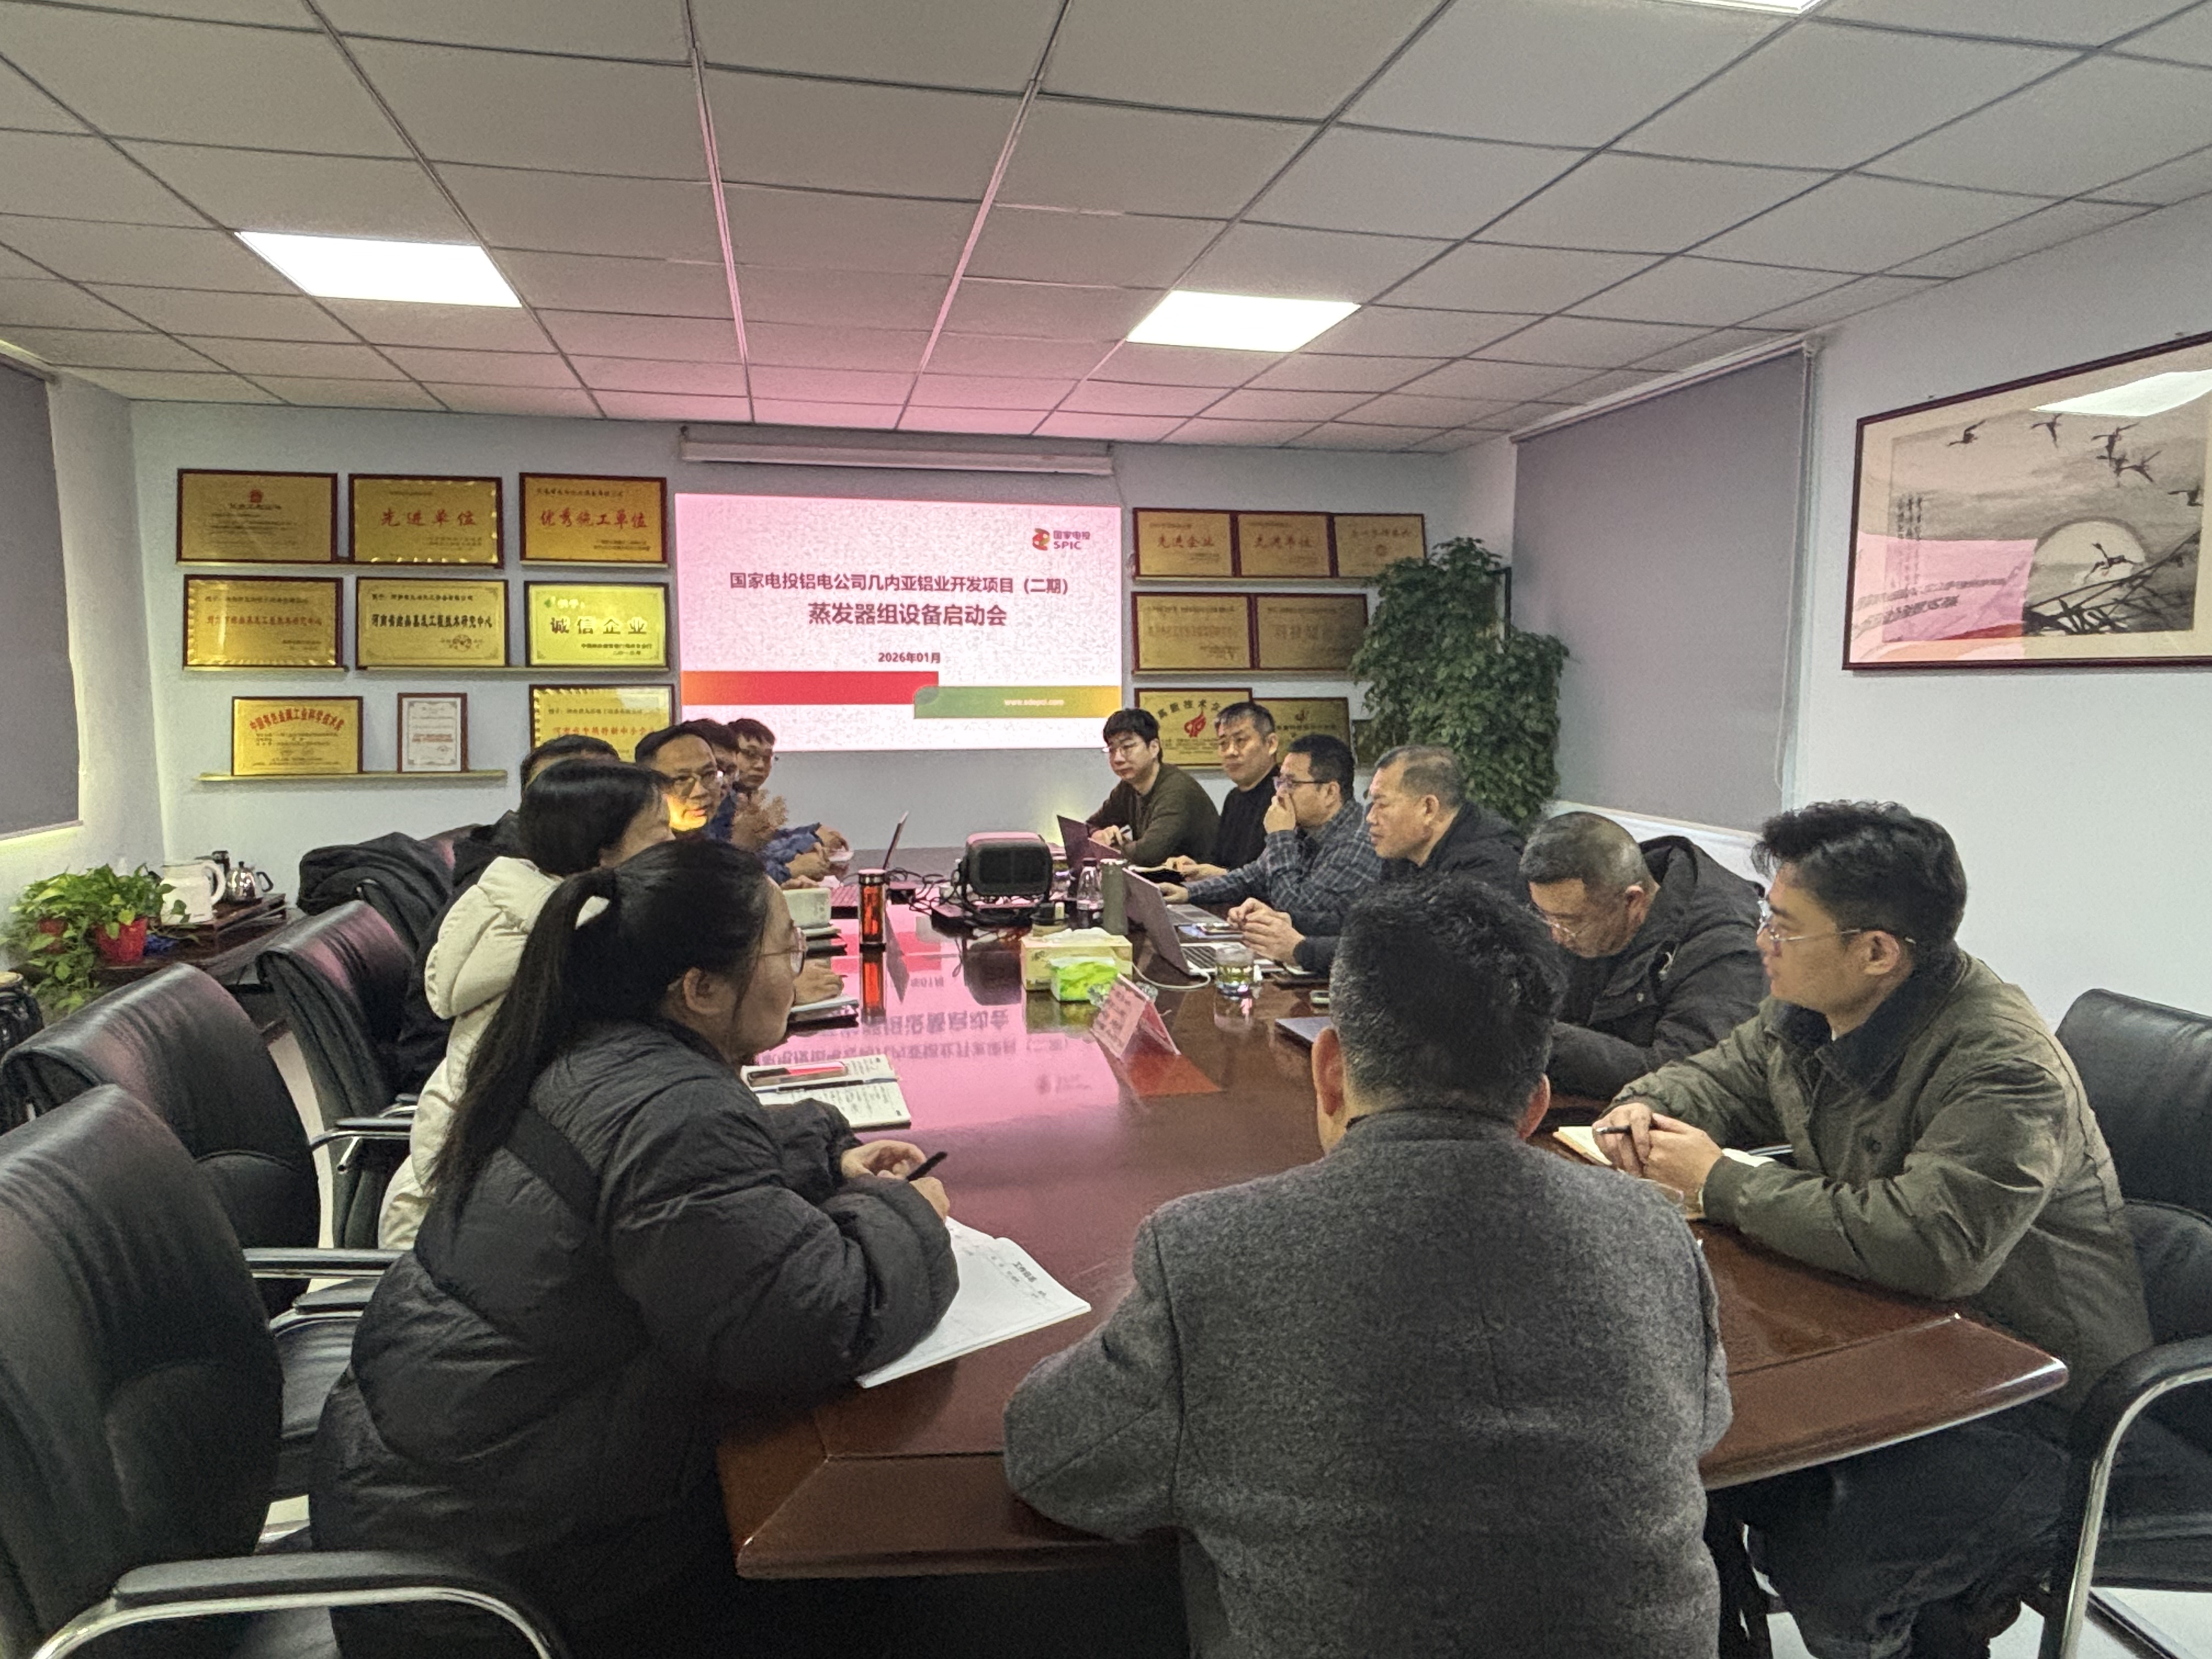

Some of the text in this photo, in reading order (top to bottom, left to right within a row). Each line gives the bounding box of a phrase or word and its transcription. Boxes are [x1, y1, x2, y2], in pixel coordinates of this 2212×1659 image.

[381, 507, 476, 527] 先进单位
[540, 507, 648, 529] 优秀施工单位
[1053, 531, 1091, 540] 国家电投
[1053, 541, 1081, 550] SPIC
[730, 572, 1068, 594] 国家电投铝电公司几内亚铝业开发项目（二期）
[808, 601, 1007, 626] 蒸发器组设备启动会
[550, 616, 647, 635] 诚信企业
[878, 652, 941, 664] 2026年01月
[1158, 698, 1221, 719] 高新技术企
